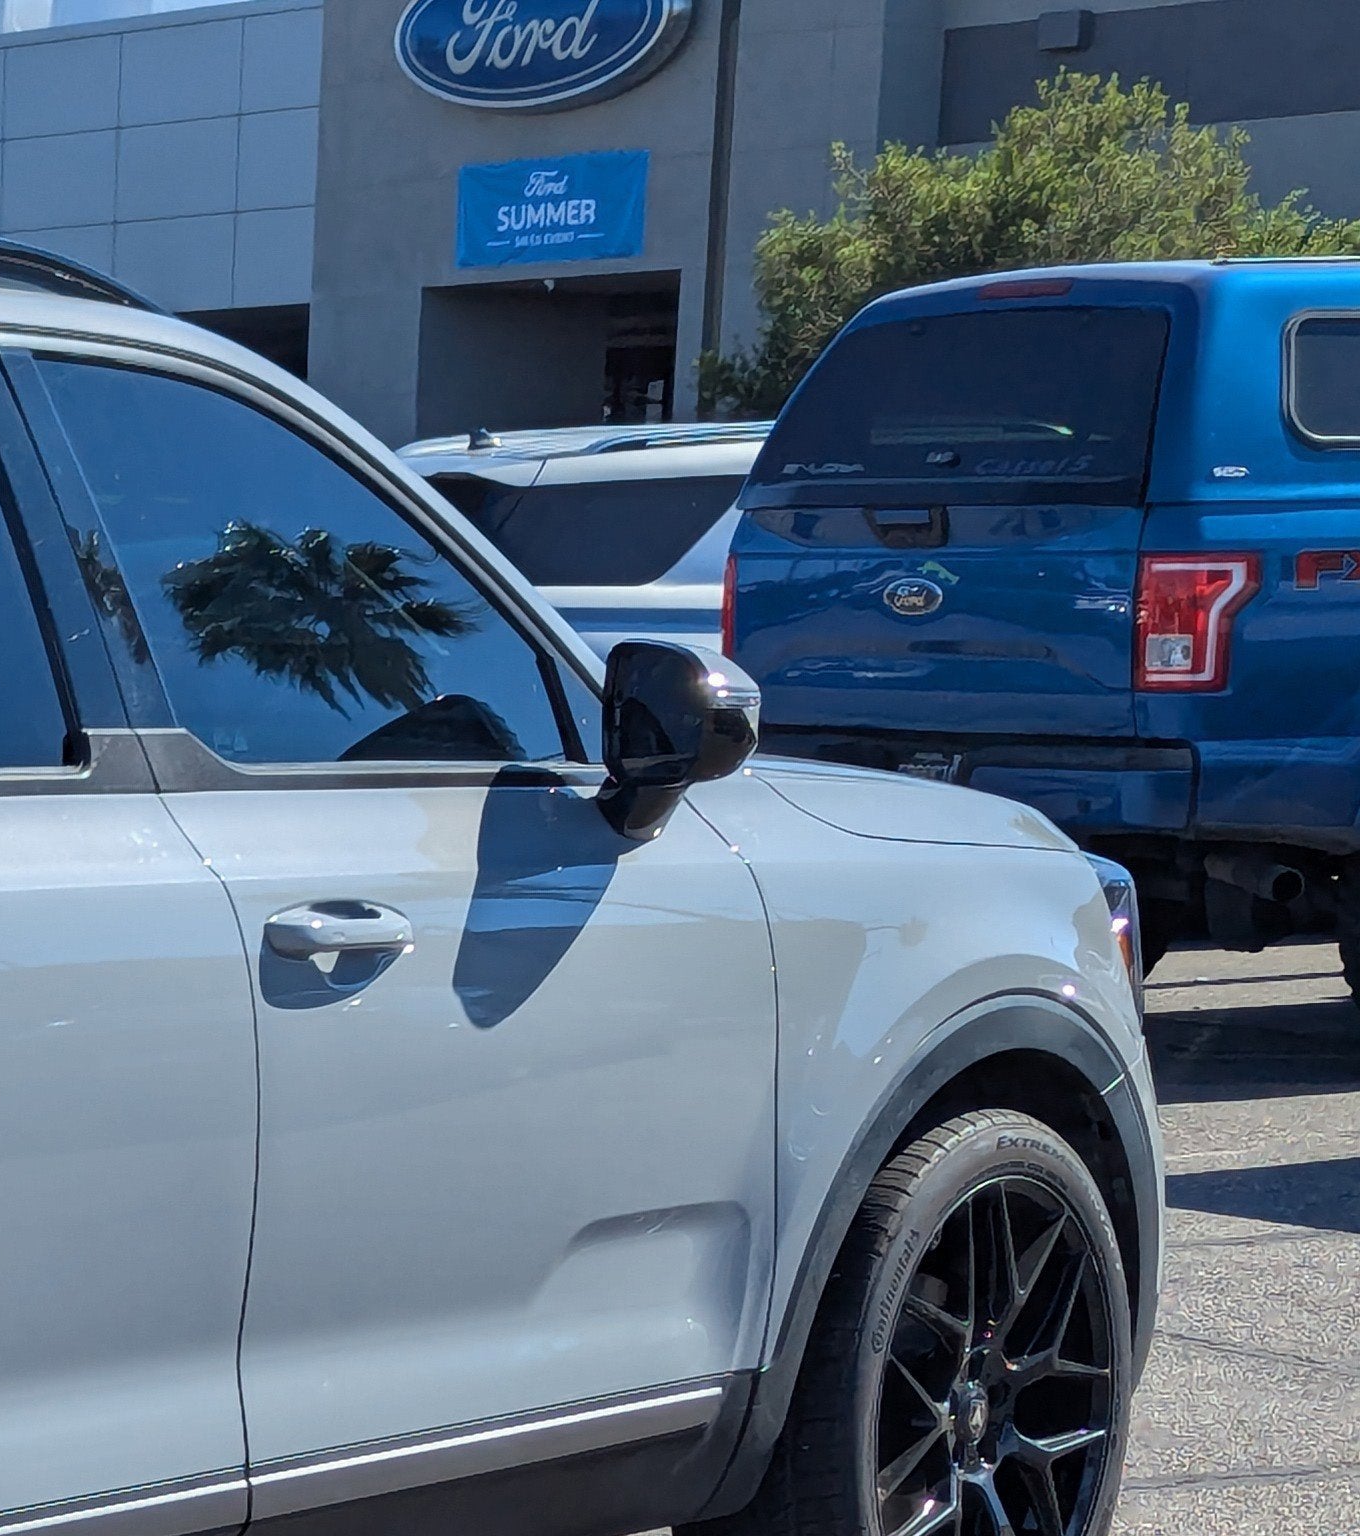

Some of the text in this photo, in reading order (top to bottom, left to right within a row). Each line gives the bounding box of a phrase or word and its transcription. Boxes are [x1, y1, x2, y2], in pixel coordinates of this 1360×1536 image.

[446, 0, 598, 75] Ford
[523, 170, 569, 198] Ford
[497, 199, 596, 232] SUMMER
[893, 585, 927, 608] Ford
